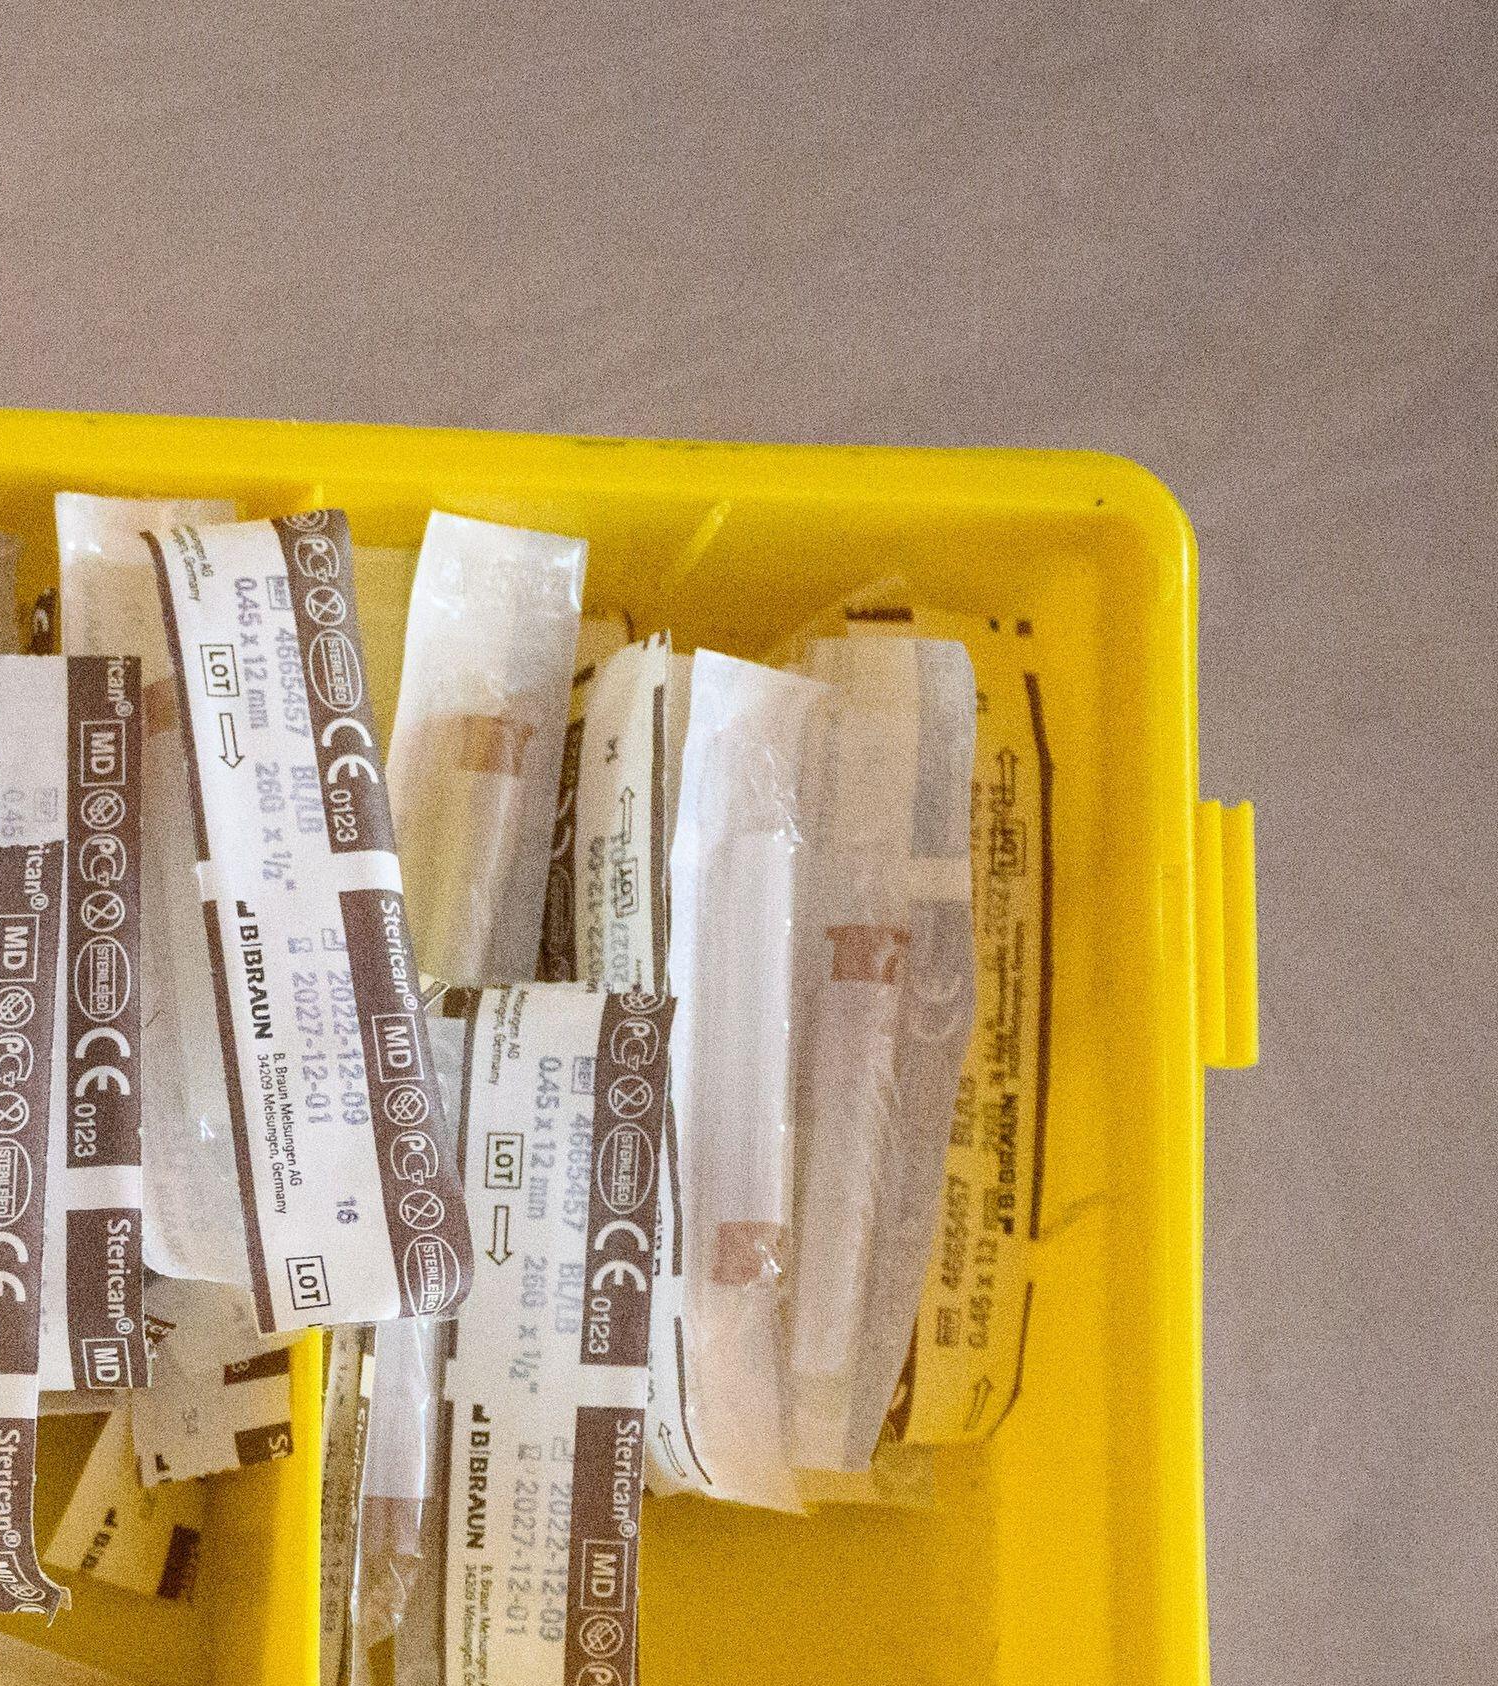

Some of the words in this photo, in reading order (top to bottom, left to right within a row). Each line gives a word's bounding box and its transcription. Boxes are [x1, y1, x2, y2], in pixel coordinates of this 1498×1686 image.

[206, 649, 230, 693] LOT
[241, 652, 269, 682] 12
[272, 625, 311, 739] 4665457
[244, 687, 269, 731] mm
[88, 731, 115, 774] MD
[254, 760, 284, 813] 26G
[330, 788, 358, 843] 0123
[2, 926, 26, 970] MD
[242, 949, 272, 1040] BRAUN
[255, 1053, 273, 1091] 34209
[289, 970, 335, 1125] 2027-12-01
[324, 967, 370, 1127] 2022-12-09
[383, 1024, 411, 1069] MD
[488, 1033, 506, 1085] Germany
[272, 1066, 290, 1101] Braun
[536, 1055, 561, 1109] 0.45
[73, 1102, 93, 1158] 0123
[259, 1092, 283, 1160] Melsungen,
[277, 1102, 300, 1167] Melsungen
[288, 1168, 302, 1186] AG
[493, 1139, 513, 1182] LOT
[531, 1140, 556, 1168] 12
[564, 1112, 592, 1232] 4665457
[268, 1161, 290, 1215] Germany
[527, 1176, 550, 1219] mm
[294, 1260, 320, 1303] LOT
[522, 1256, 547, 1309] 26G
[588, 1296, 610, 1354] 0123
[92, 1345, 119, 1382] MD
[465, 1456, 486, 1549] BRAUN
[503, 1479, 537, 1636] 2027-12-01
[538, 1482, 571, 1642] 2022-12-09
[590, 1552, 615, 1598] MD
